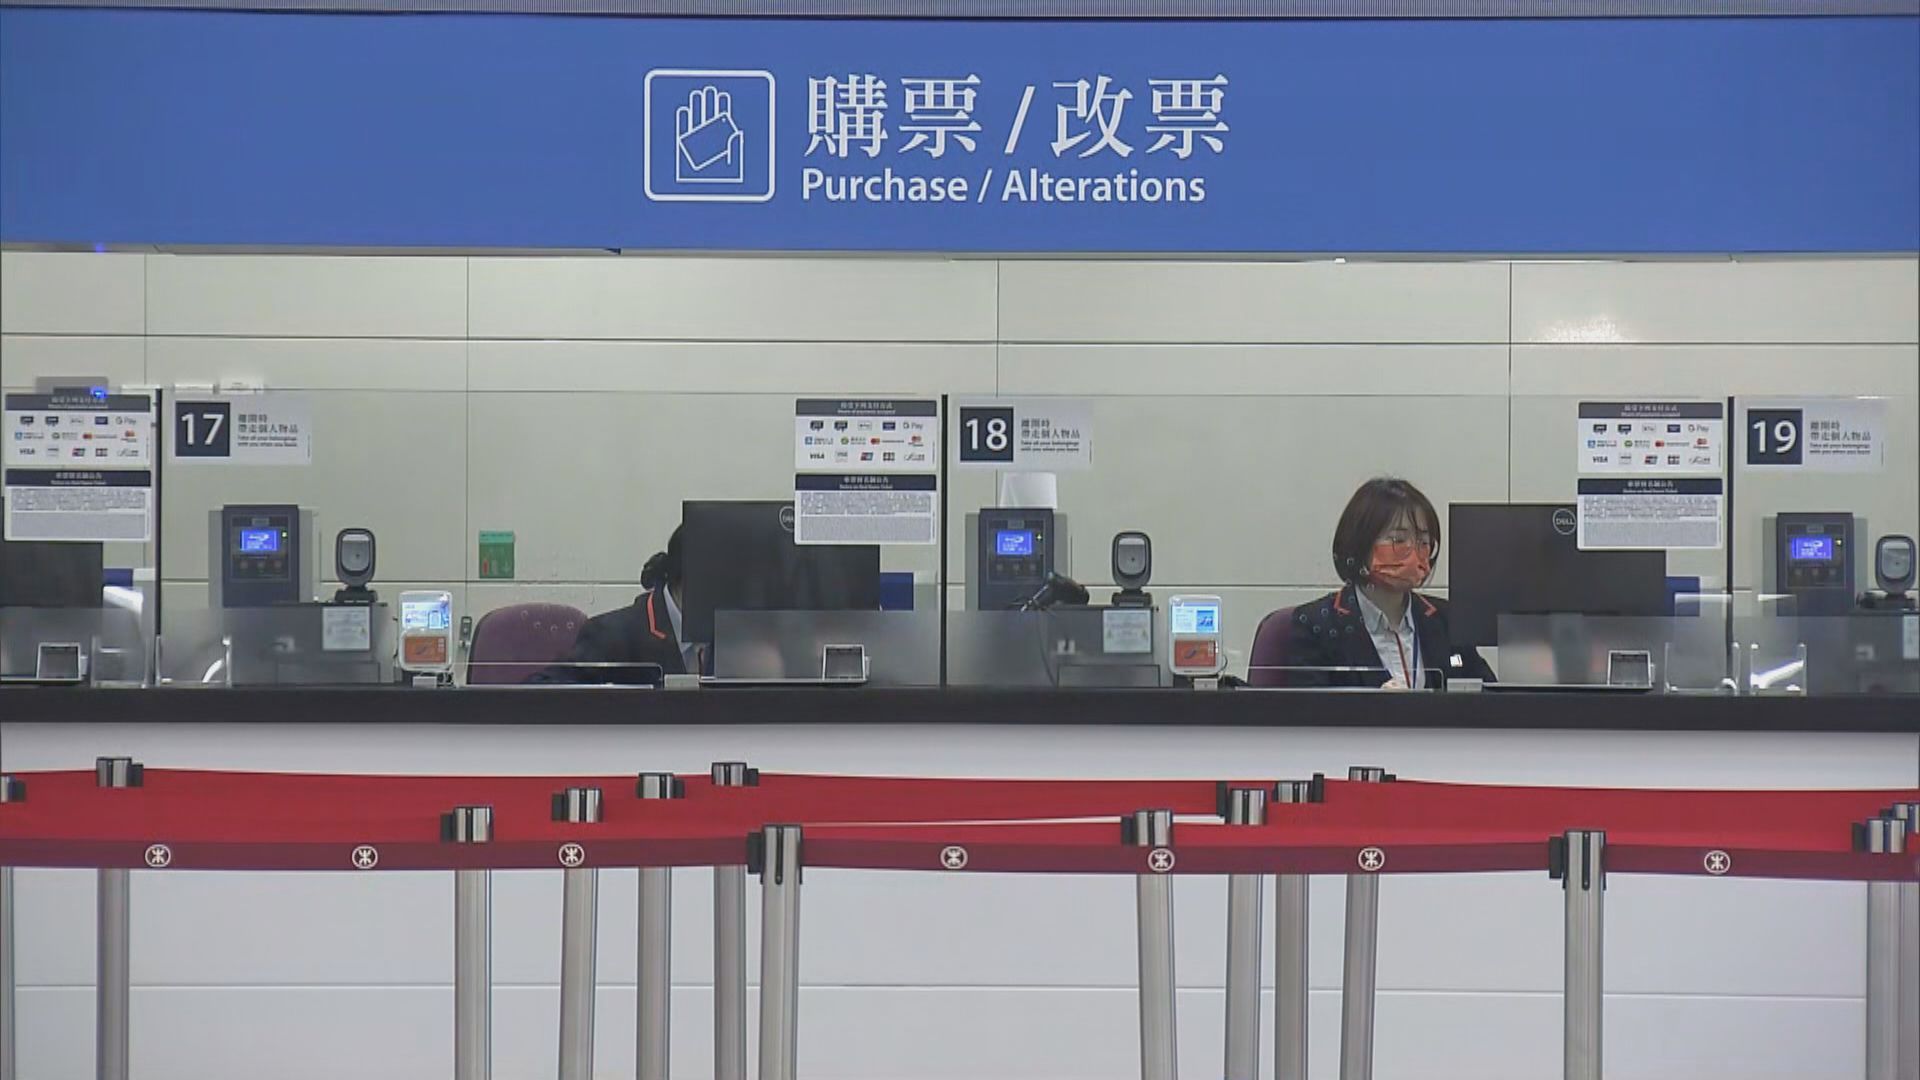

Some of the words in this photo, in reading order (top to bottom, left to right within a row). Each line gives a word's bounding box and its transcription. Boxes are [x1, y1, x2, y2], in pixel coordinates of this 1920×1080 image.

[804, 73, 982, 158] 購票
[1050, 74, 1230, 159] 改票
[802, 167, 968, 201] Purchase
[1001, 168, 1205, 202] Alterations
[181, 413, 224, 445] 17
[966, 418, 1008, 451] 18
[1753, 420, 1797, 453] 19
